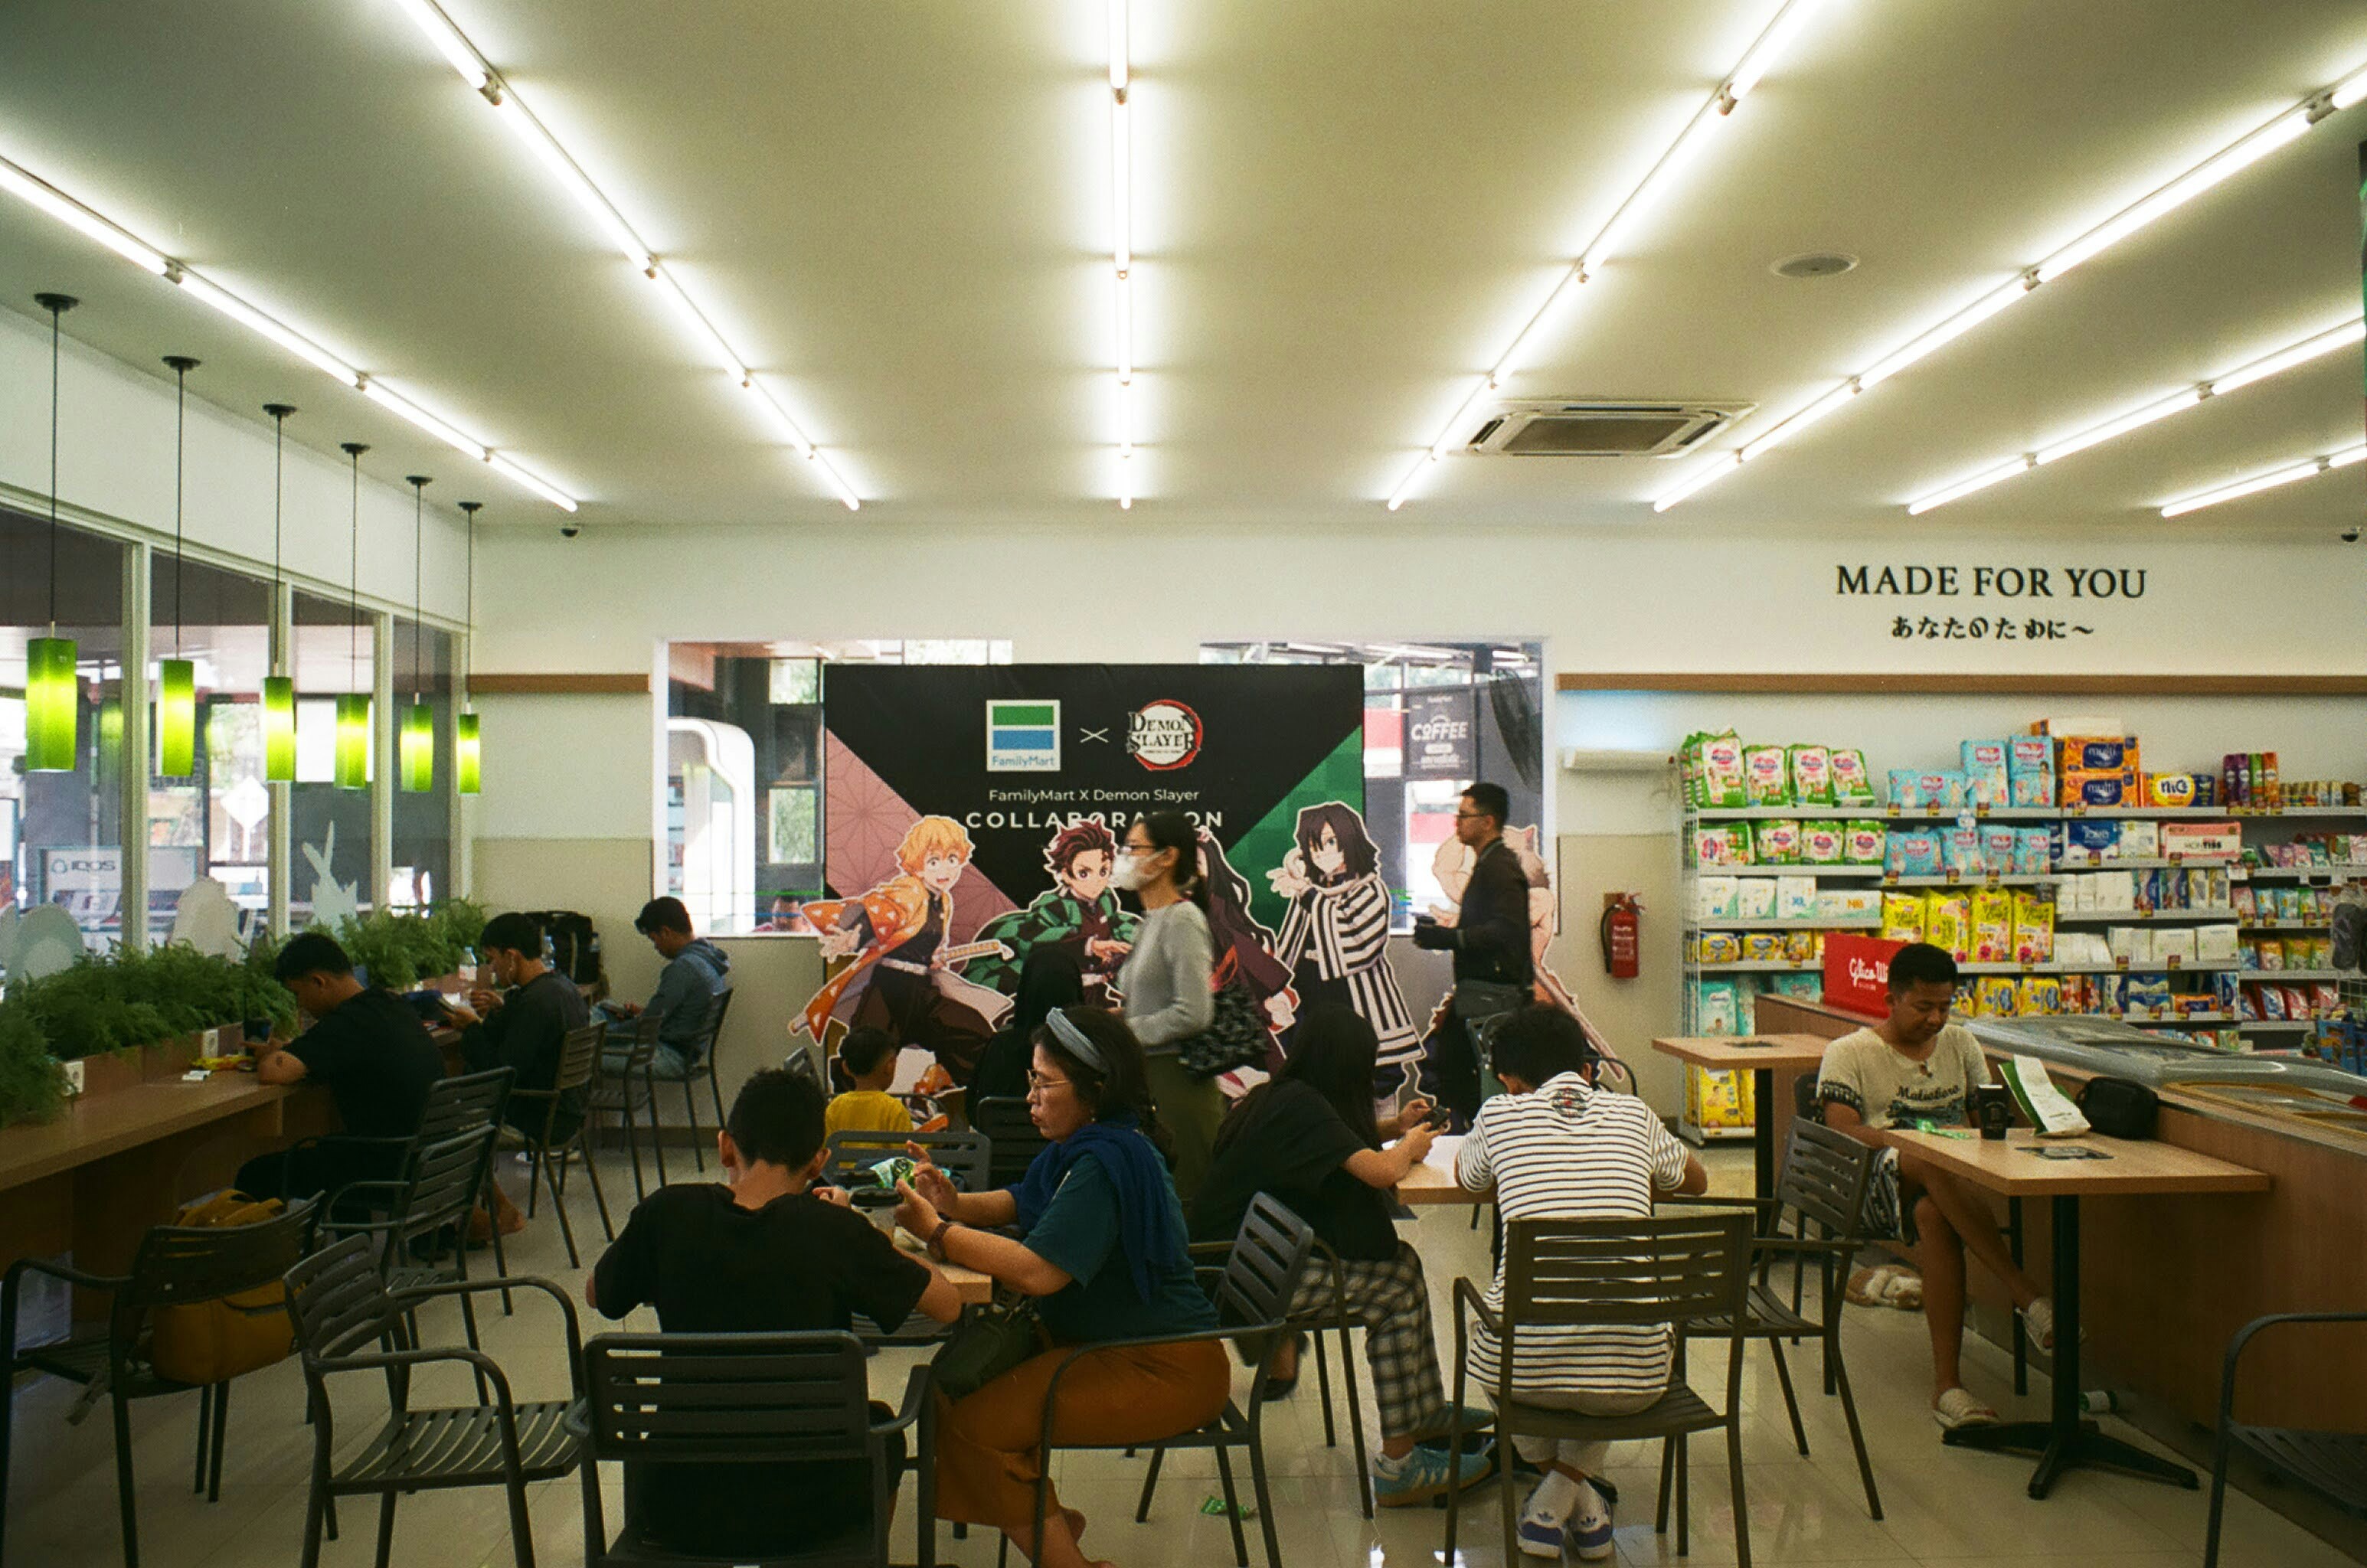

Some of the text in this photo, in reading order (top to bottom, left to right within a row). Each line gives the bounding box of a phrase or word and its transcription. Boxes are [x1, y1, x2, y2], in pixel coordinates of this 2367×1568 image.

[1836, 565, 2146, 598] MADE FOR YOU
[1128, 711, 1199, 732] DEMON
[1411, 722, 1469, 740] COFFEE
[1126, 732, 1201, 753] SLAYER
[992, 756, 1054, 766] FamilyMart
[989, 789, 1200, 803] FamilyMart X Demon Slayer
